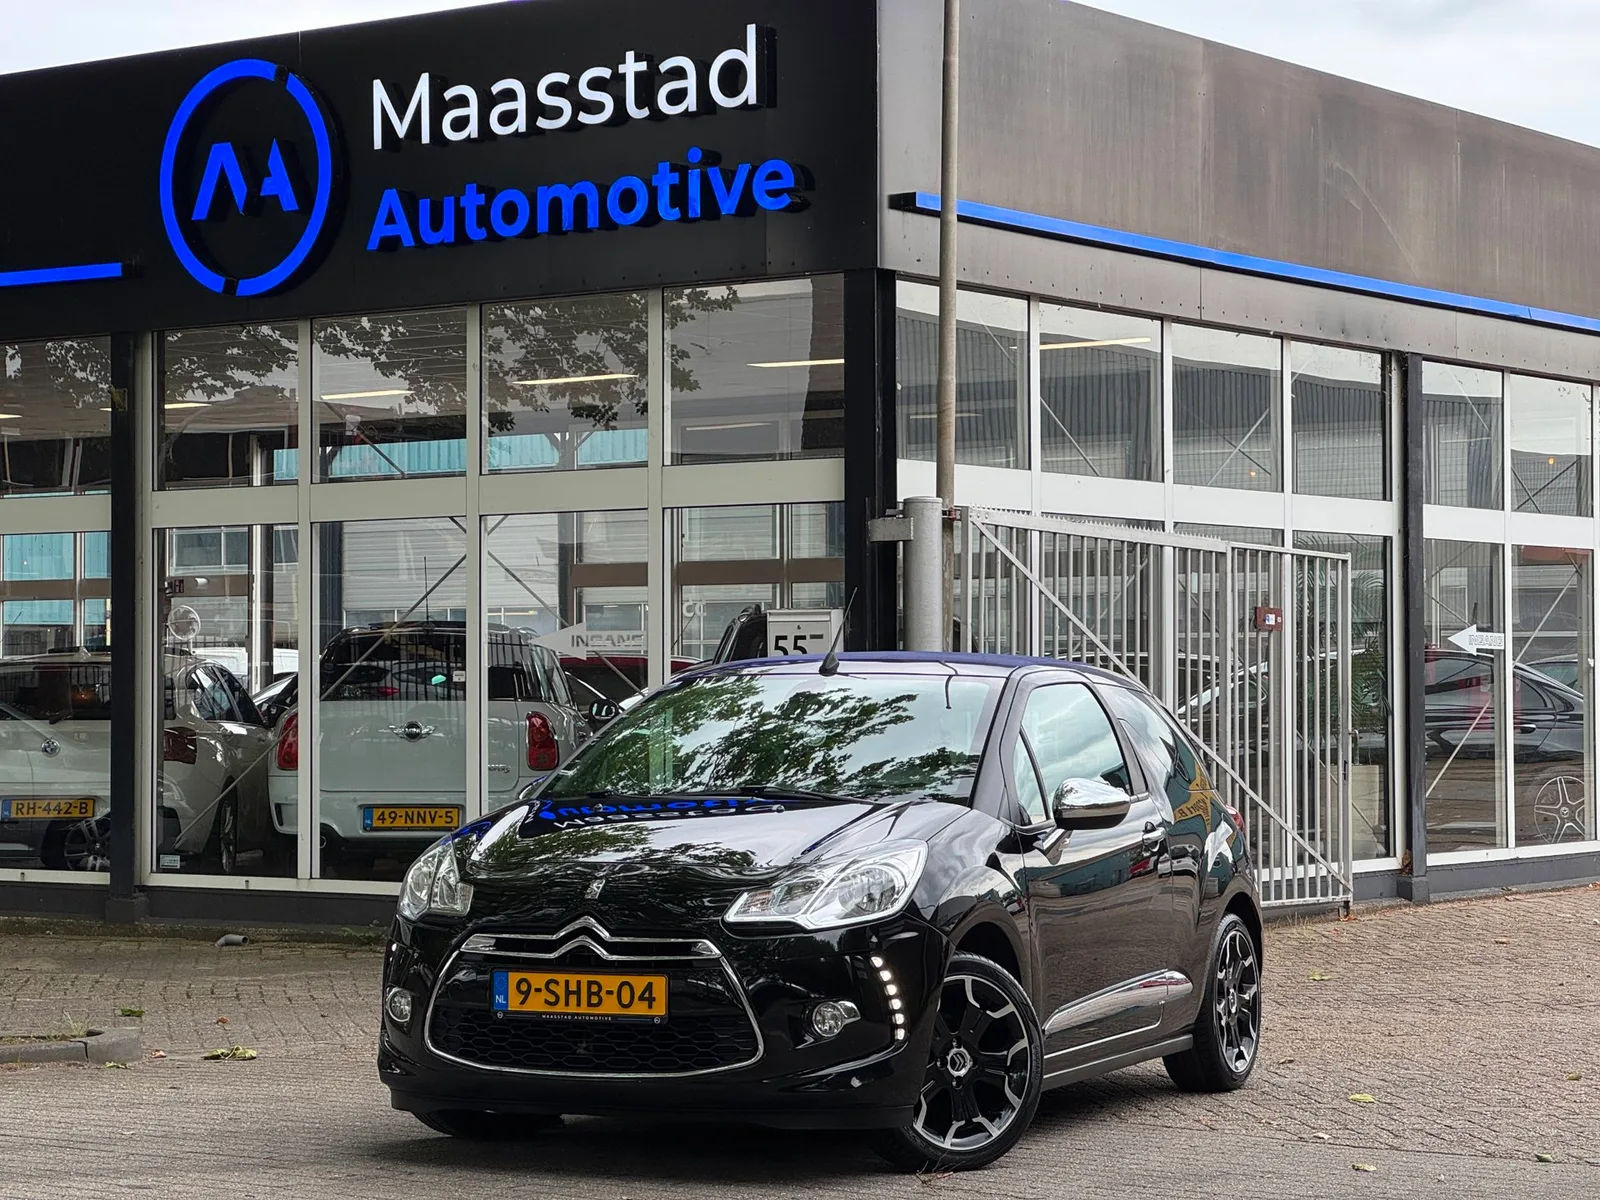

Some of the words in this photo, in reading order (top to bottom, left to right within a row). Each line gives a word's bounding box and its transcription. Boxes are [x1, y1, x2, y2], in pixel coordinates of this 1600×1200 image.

[373, 23, 758, 150] Maasstad
[366, 146, 795, 250] Automotive
[15, 801, 88, 816] RH-442-B
[376, 810, 454, 824] 49-NNV-5
[495, 994, 507, 1004] NL
[515, 977, 657, 1010] 9-SHB-04
